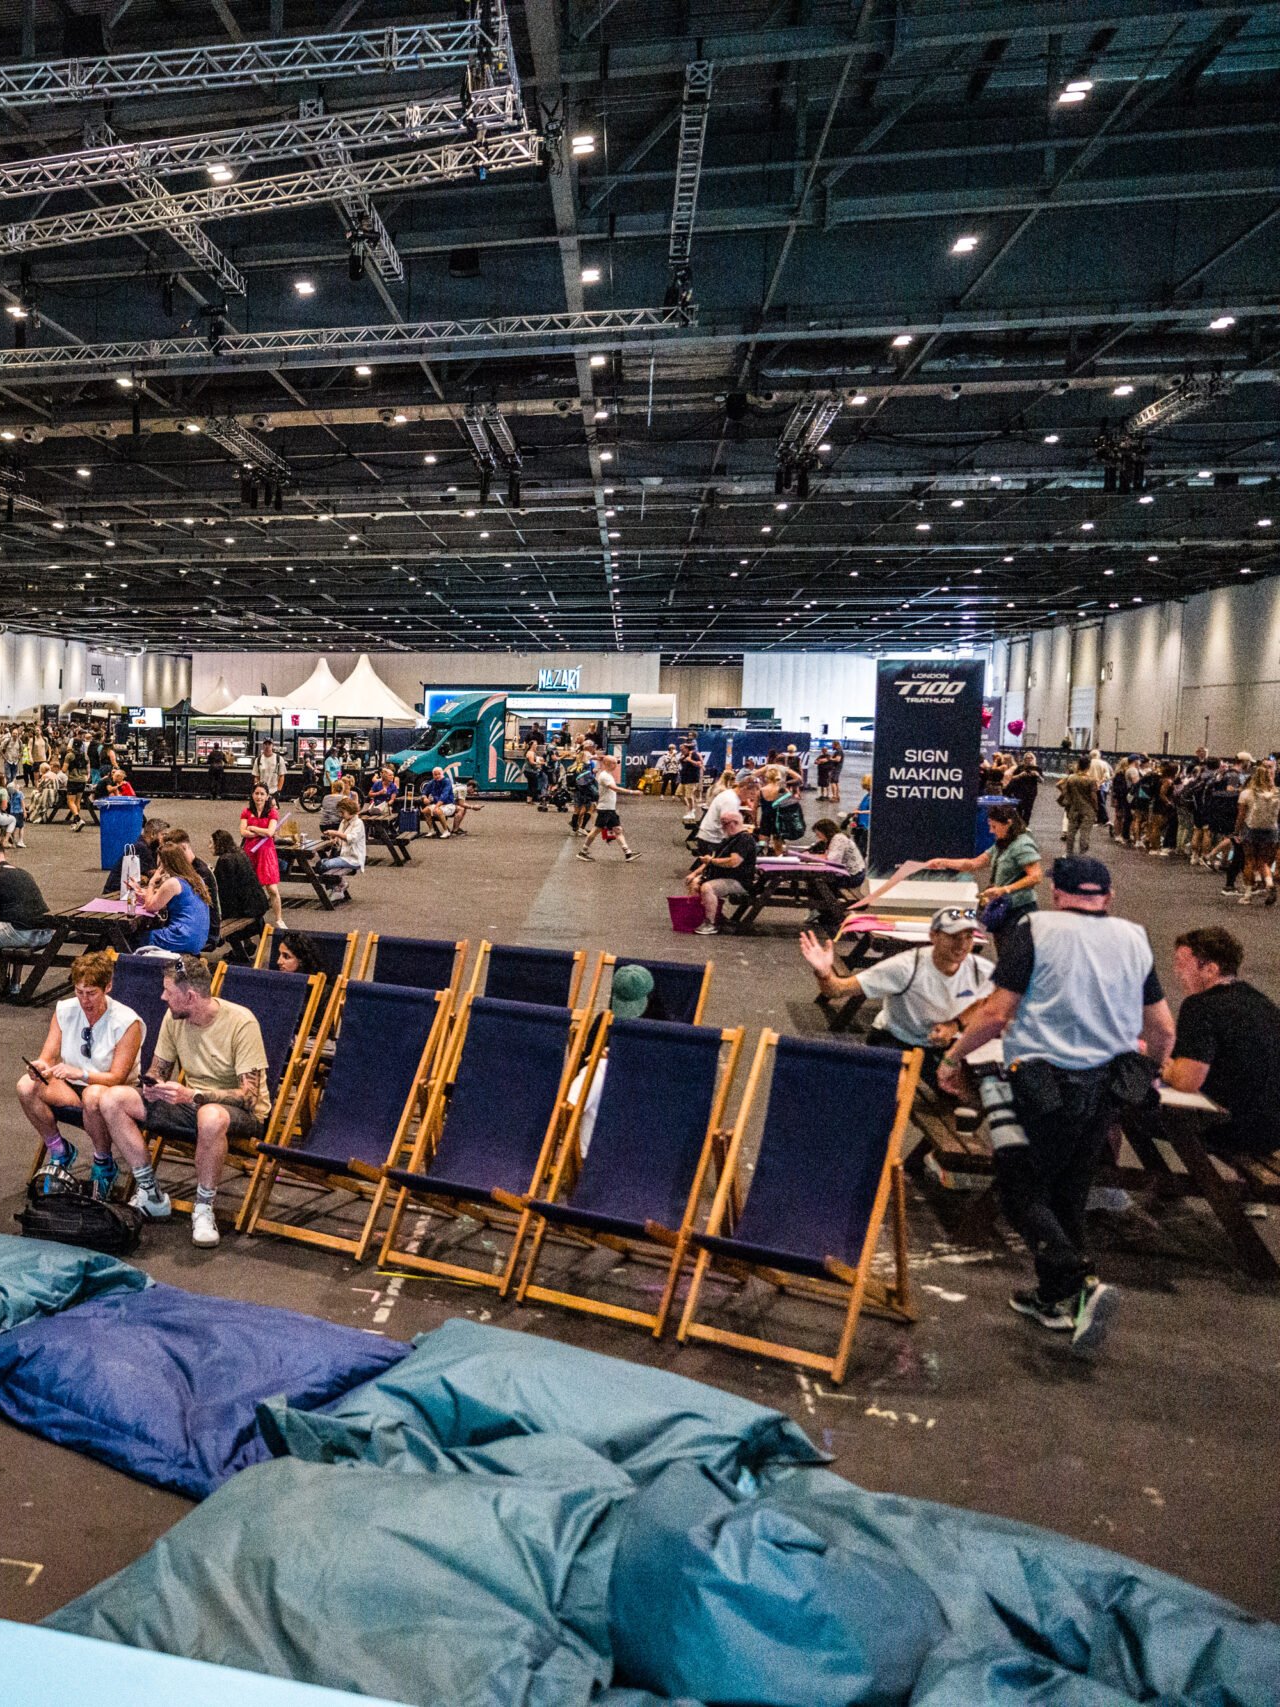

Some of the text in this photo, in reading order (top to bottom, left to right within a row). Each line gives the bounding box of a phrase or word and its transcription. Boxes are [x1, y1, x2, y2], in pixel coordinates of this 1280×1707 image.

[894, 681, 967, 696] T100
[77, 698, 107, 709] faster
[625, 755, 648, 766] DON
[904, 749, 949, 763] SIGN
[889, 767, 963, 782] MAKING
[885, 785, 964, 800] STATION
